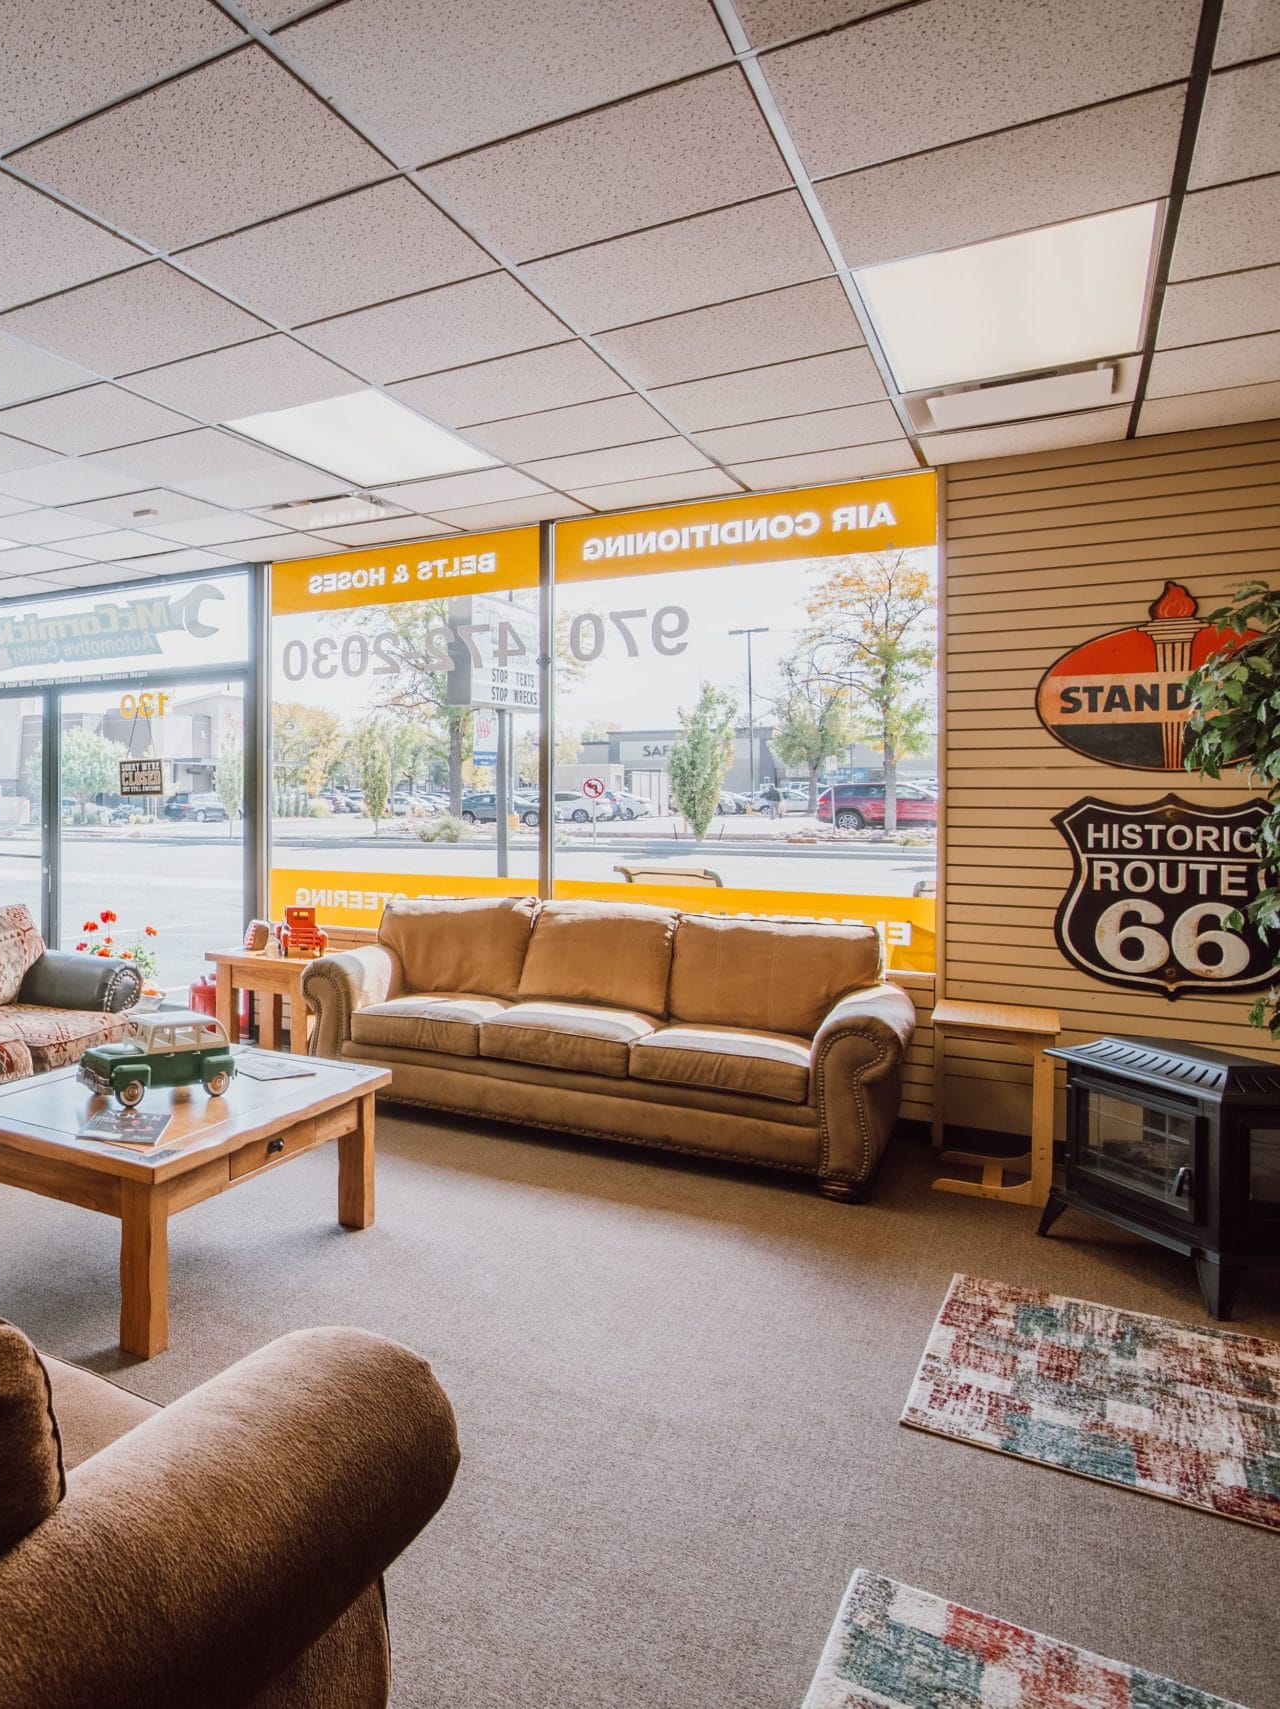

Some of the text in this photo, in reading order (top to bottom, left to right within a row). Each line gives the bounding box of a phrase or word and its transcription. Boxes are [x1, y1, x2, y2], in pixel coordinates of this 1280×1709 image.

[491, 668, 534, 688] STOP TEXTS
[491, 686, 538, 706] STOP WRECKS
[1060, 683, 1201, 714] STAND
[642, 744, 670, 757] SAF
[1087, 822, 1257, 853] HISTORIC
[1093, 860, 1248, 897] ROUTE
[1095, 898, 1251, 979] 66
